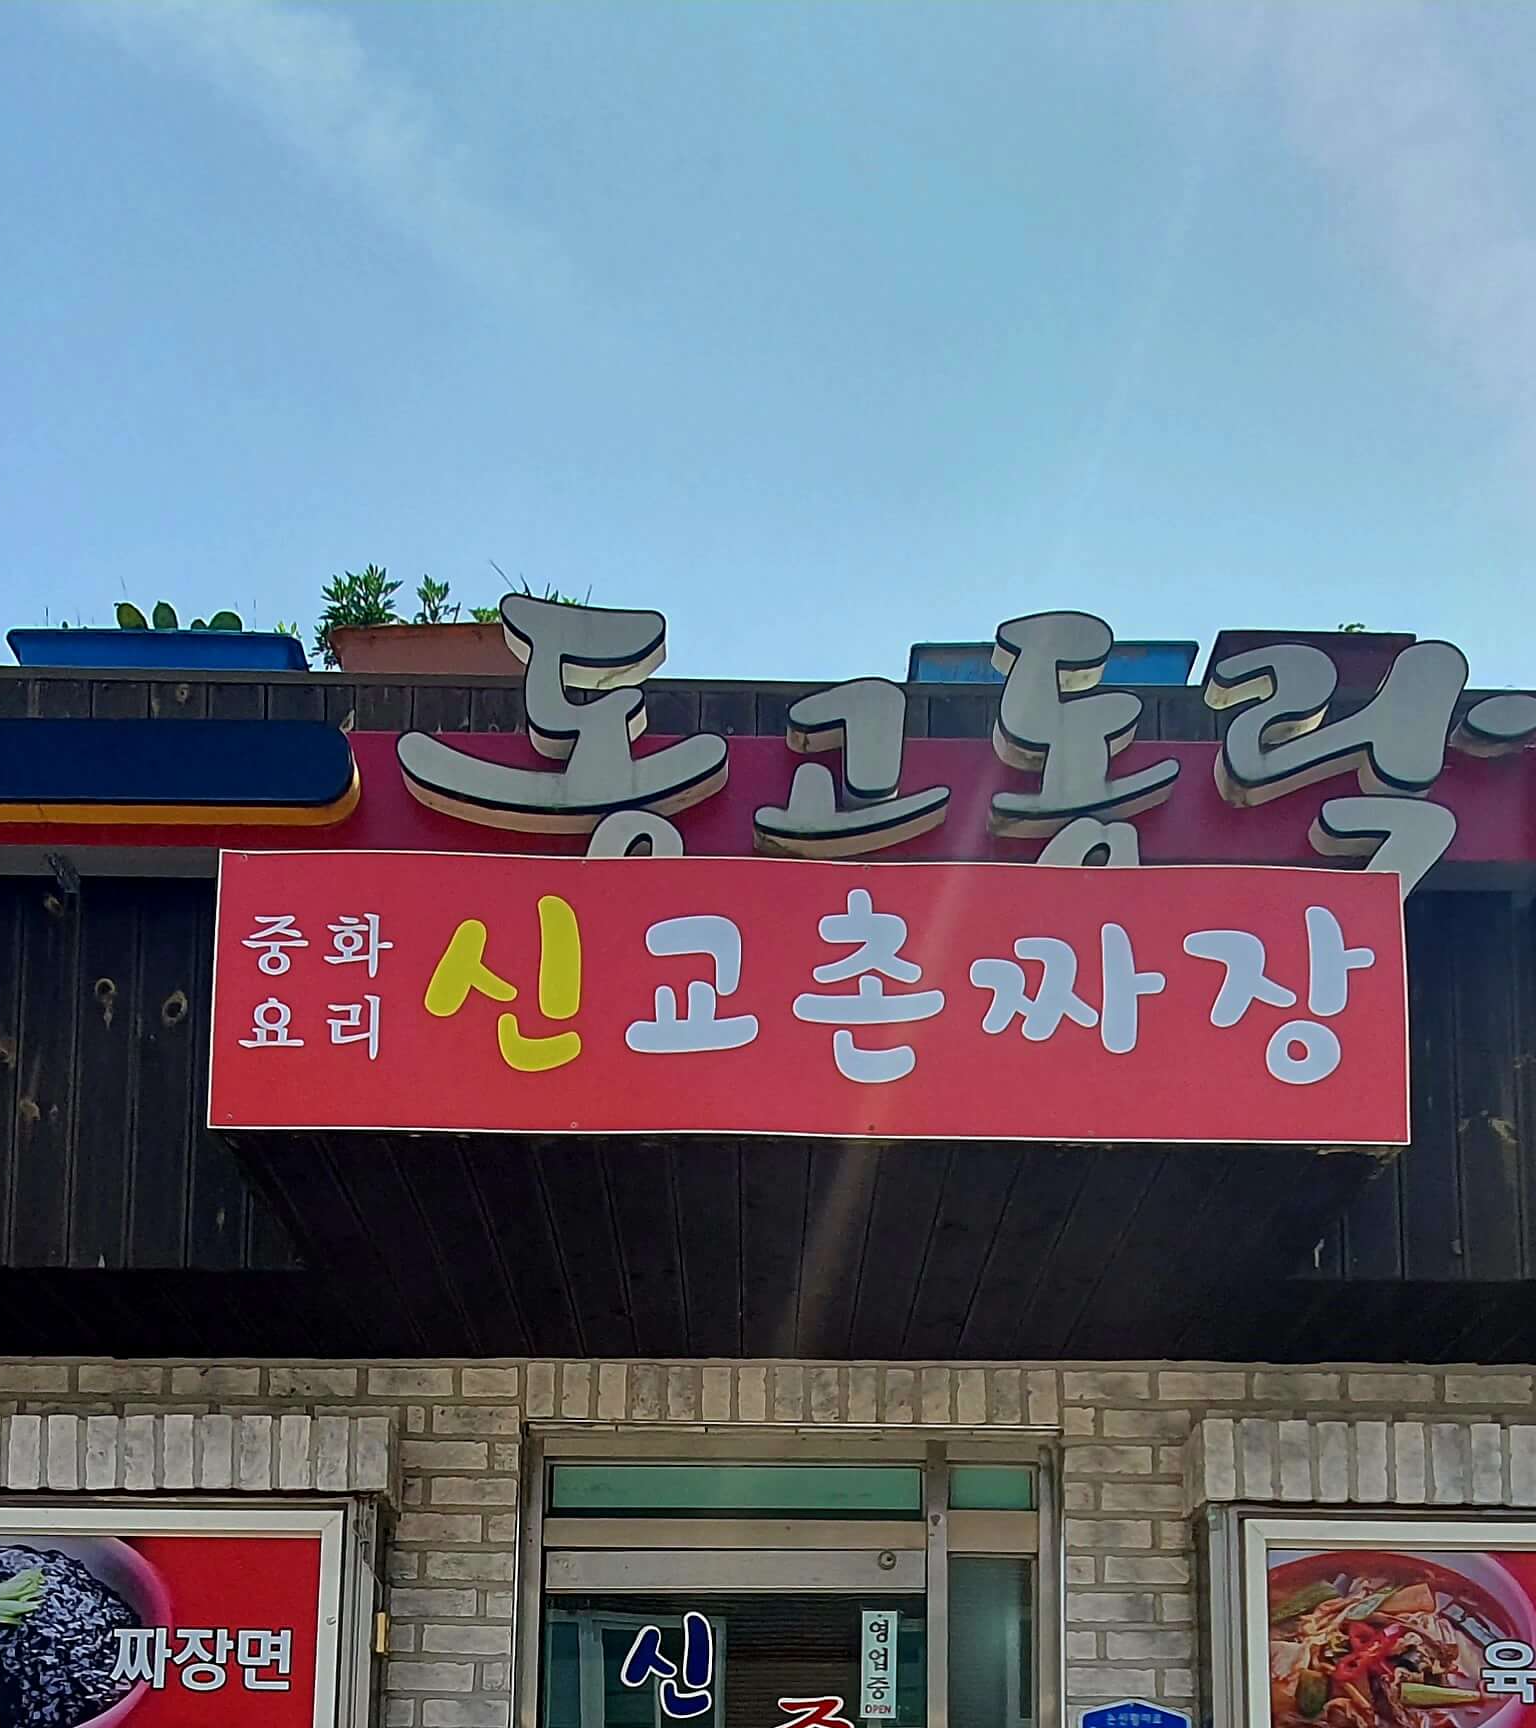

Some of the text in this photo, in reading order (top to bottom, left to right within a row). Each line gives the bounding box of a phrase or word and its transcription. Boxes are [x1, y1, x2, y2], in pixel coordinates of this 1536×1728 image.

[241, 913, 393, 978] 중화
[424, 888, 1375, 1083] 신교촌짜장
[239, 995, 382, 1061] 요리
[109, 1626, 293, 1691] 짜장면
[866, 1619, 891, 1700] 영업중
[864, 1704, 892, 1714] OPEN
